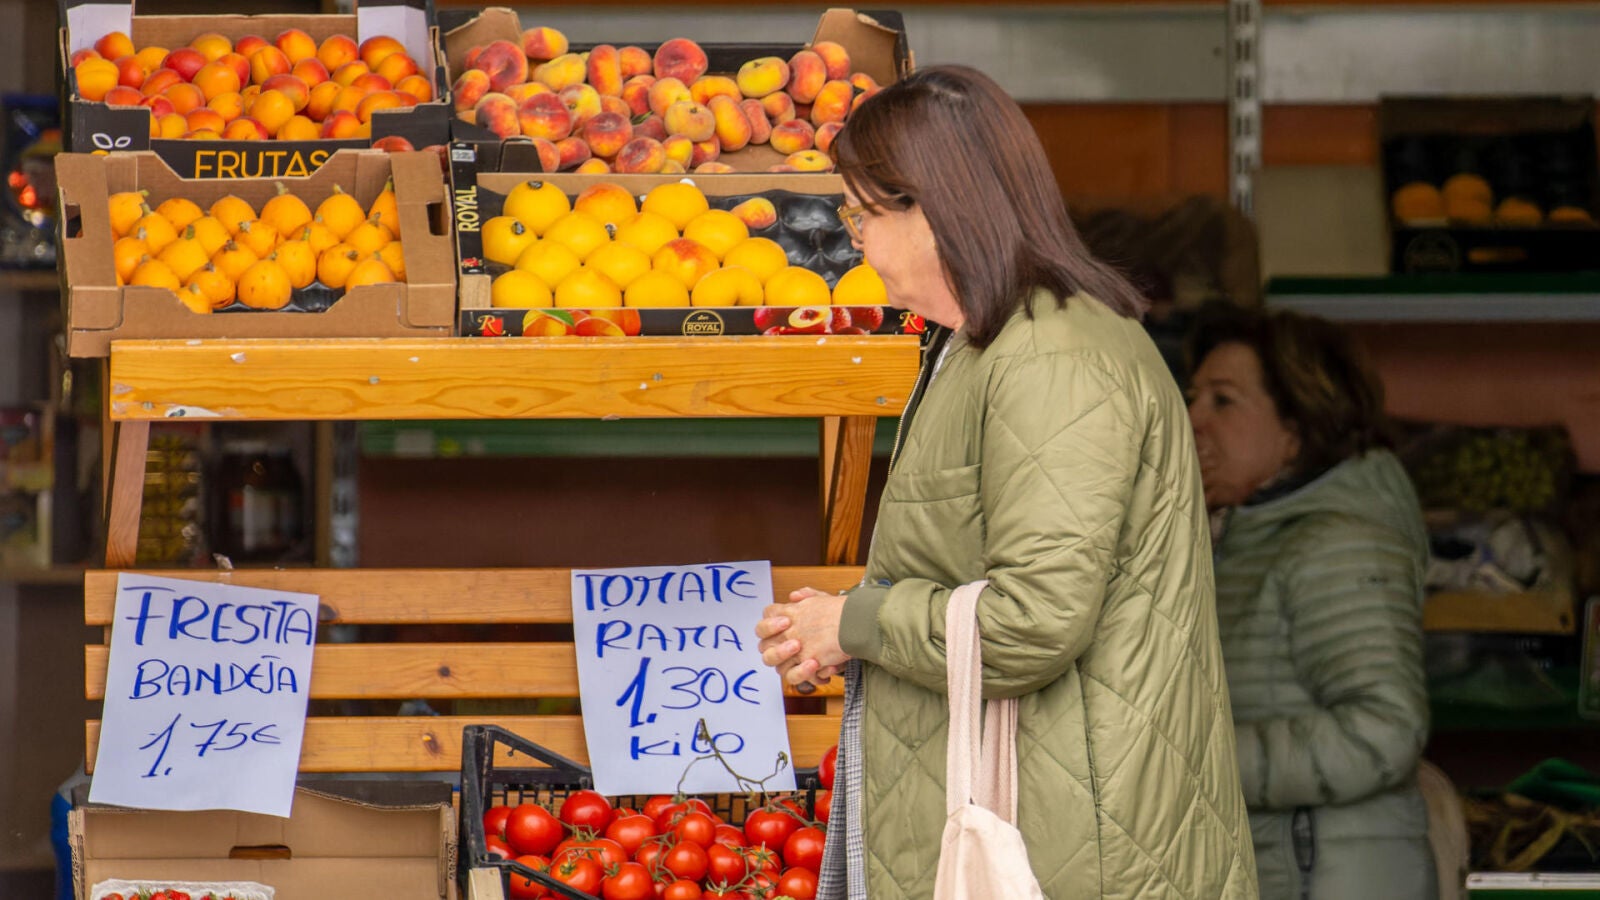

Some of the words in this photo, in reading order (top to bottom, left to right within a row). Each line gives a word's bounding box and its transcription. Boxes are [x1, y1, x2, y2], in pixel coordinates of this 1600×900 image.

[194, 150, 330, 179] FRUTAS
[455, 185, 480, 232] ROYAL
[477, 315, 507, 335] R
[576, 565, 759, 611] TOMATE
[123, 587, 312, 646] FRESITA
[596, 620, 743, 658] RAMA
[129, 655, 298, 699] BANDEJA
